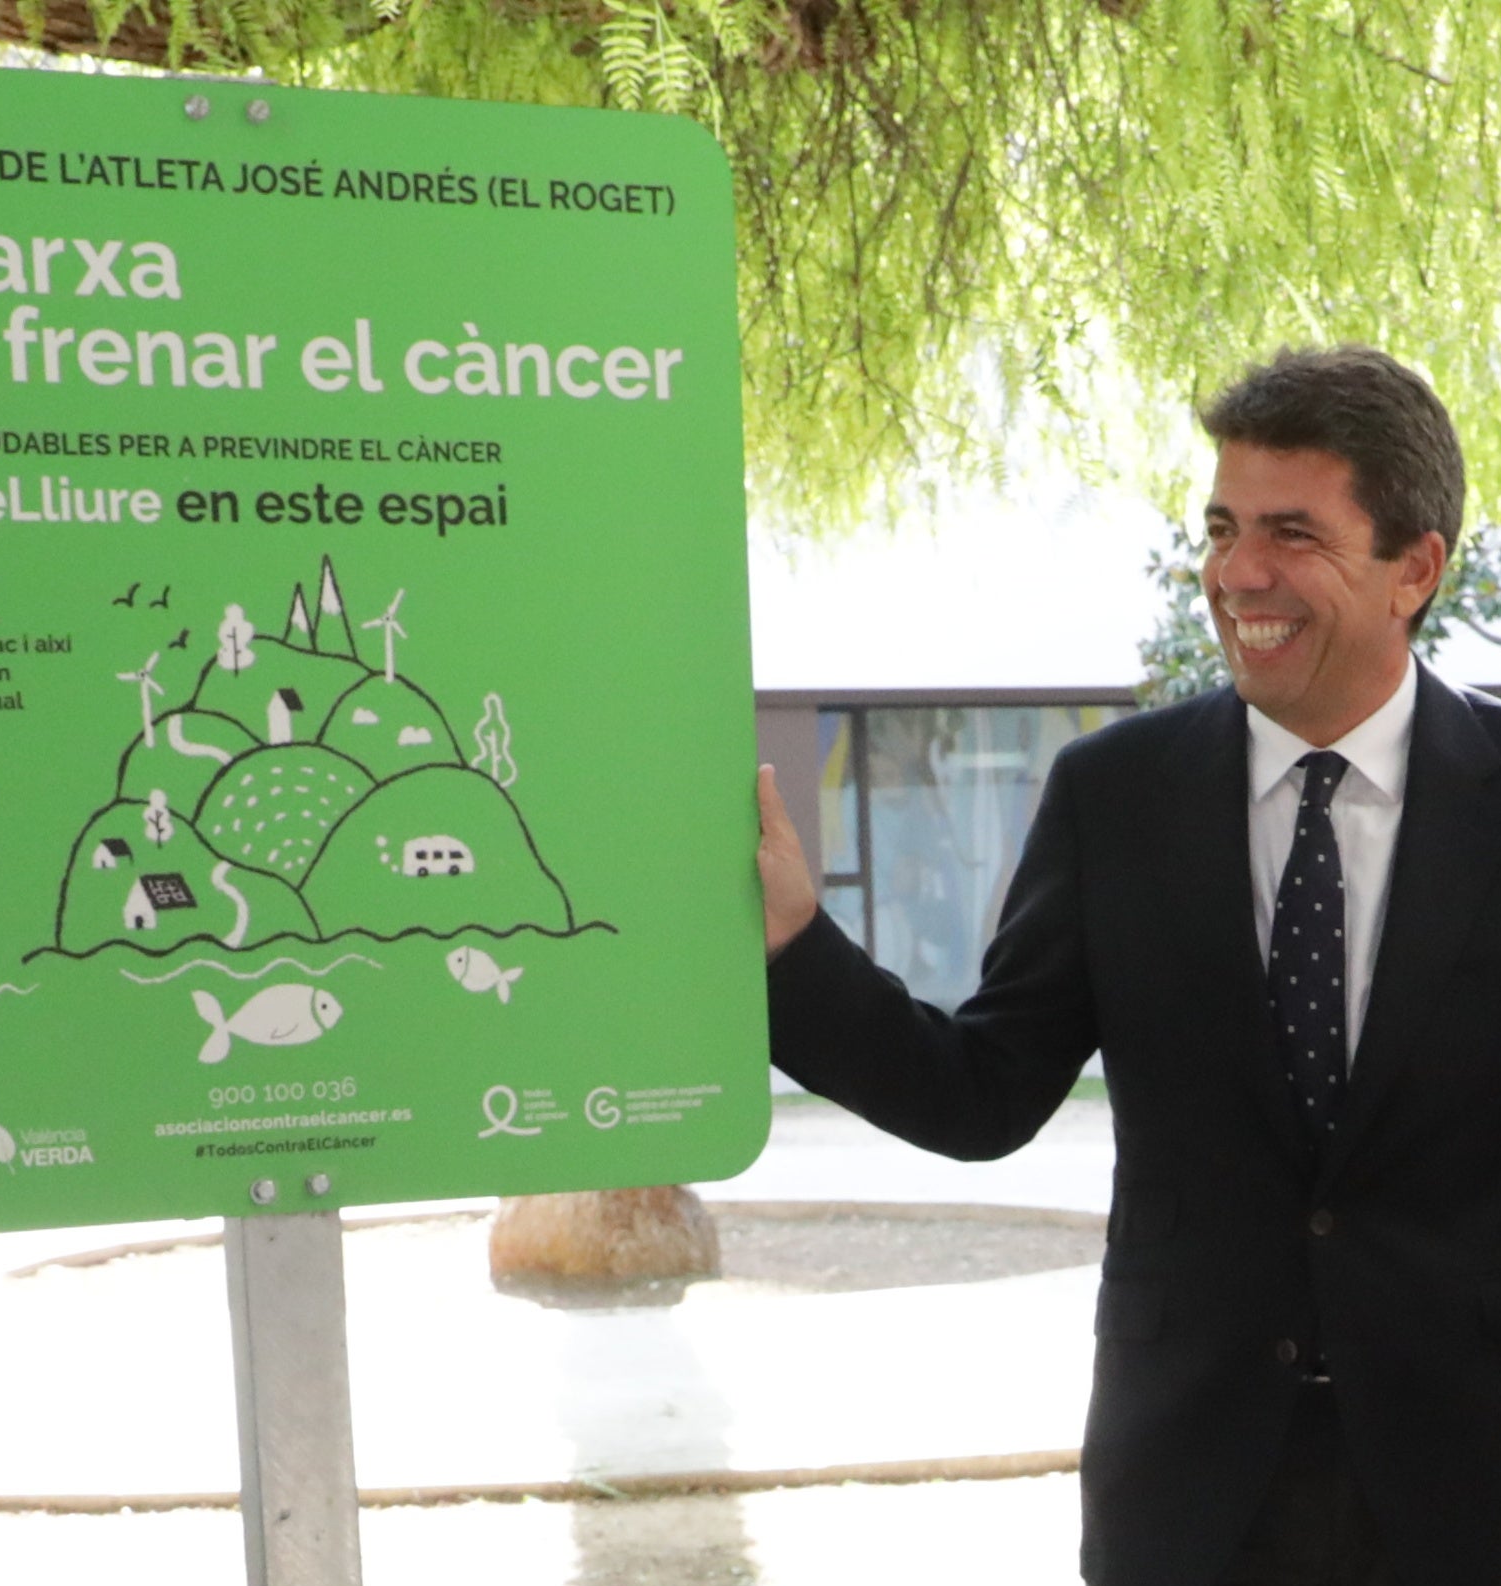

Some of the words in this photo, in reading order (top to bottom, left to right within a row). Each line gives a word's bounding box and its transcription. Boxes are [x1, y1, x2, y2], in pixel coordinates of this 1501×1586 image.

[59, 152, 225, 192] L'ATLETA
[232, 159, 324, 198] JOSÉ
[333, 166, 479, 205] ANDRÉS
[487, 176, 542, 209] (EL
[549, 180, 675, 216] ROGET)
[2, 305, 278, 390] frenar
[300, 317, 385, 393] el
[403, 321, 684, 401] càncer
[118, 433, 170, 457] PER
[178, 435, 197, 458] A
[202, 435, 353, 461] PREVINDRE
[360, 439, 391, 462] EL
[397, 435, 502, 463] CÀNCER
[176, 489, 240, 523] en
[255, 483, 364, 525] este
[378, 483, 508, 538] espai
[22, 635, 29, 653] i
[209, 1086, 255, 1108] 900
[264, 1083, 305, 1102] 100
[313, 1077, 356, 1101] 036
[155, 1108, 413, 1137] asociacioncontraelcancer.es
[19, 1145, 95, 1167] VERDA
